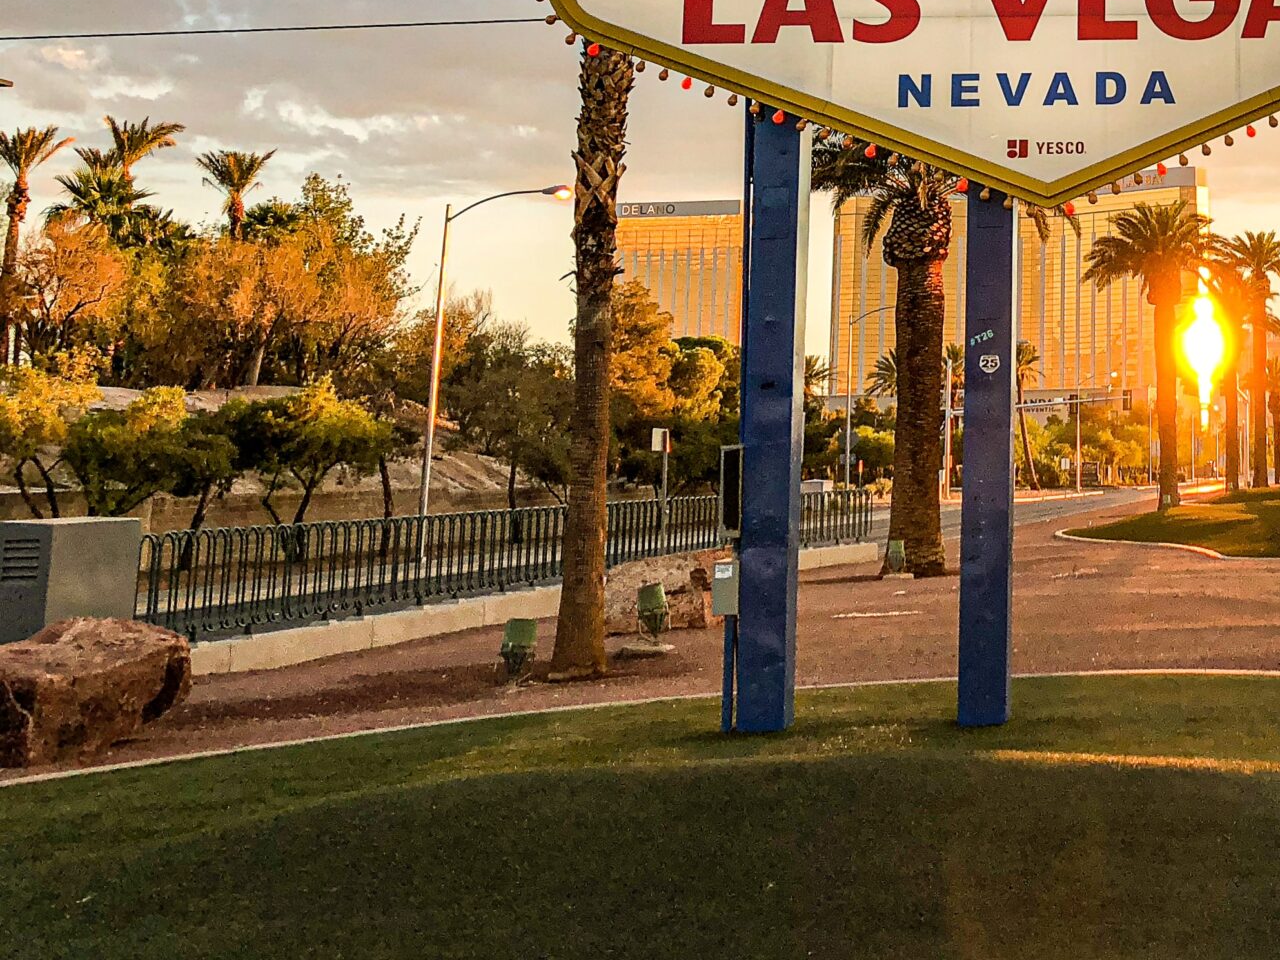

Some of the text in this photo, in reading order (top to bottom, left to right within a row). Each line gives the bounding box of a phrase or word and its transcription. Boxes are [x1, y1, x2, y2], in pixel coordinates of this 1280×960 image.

[897, 71, 1176, 108] NEVADA
[1036, 141, 1085, 155] YESCO
[621, 204, 676, 216] DELANO
[981, 359, 999, 369] 25
